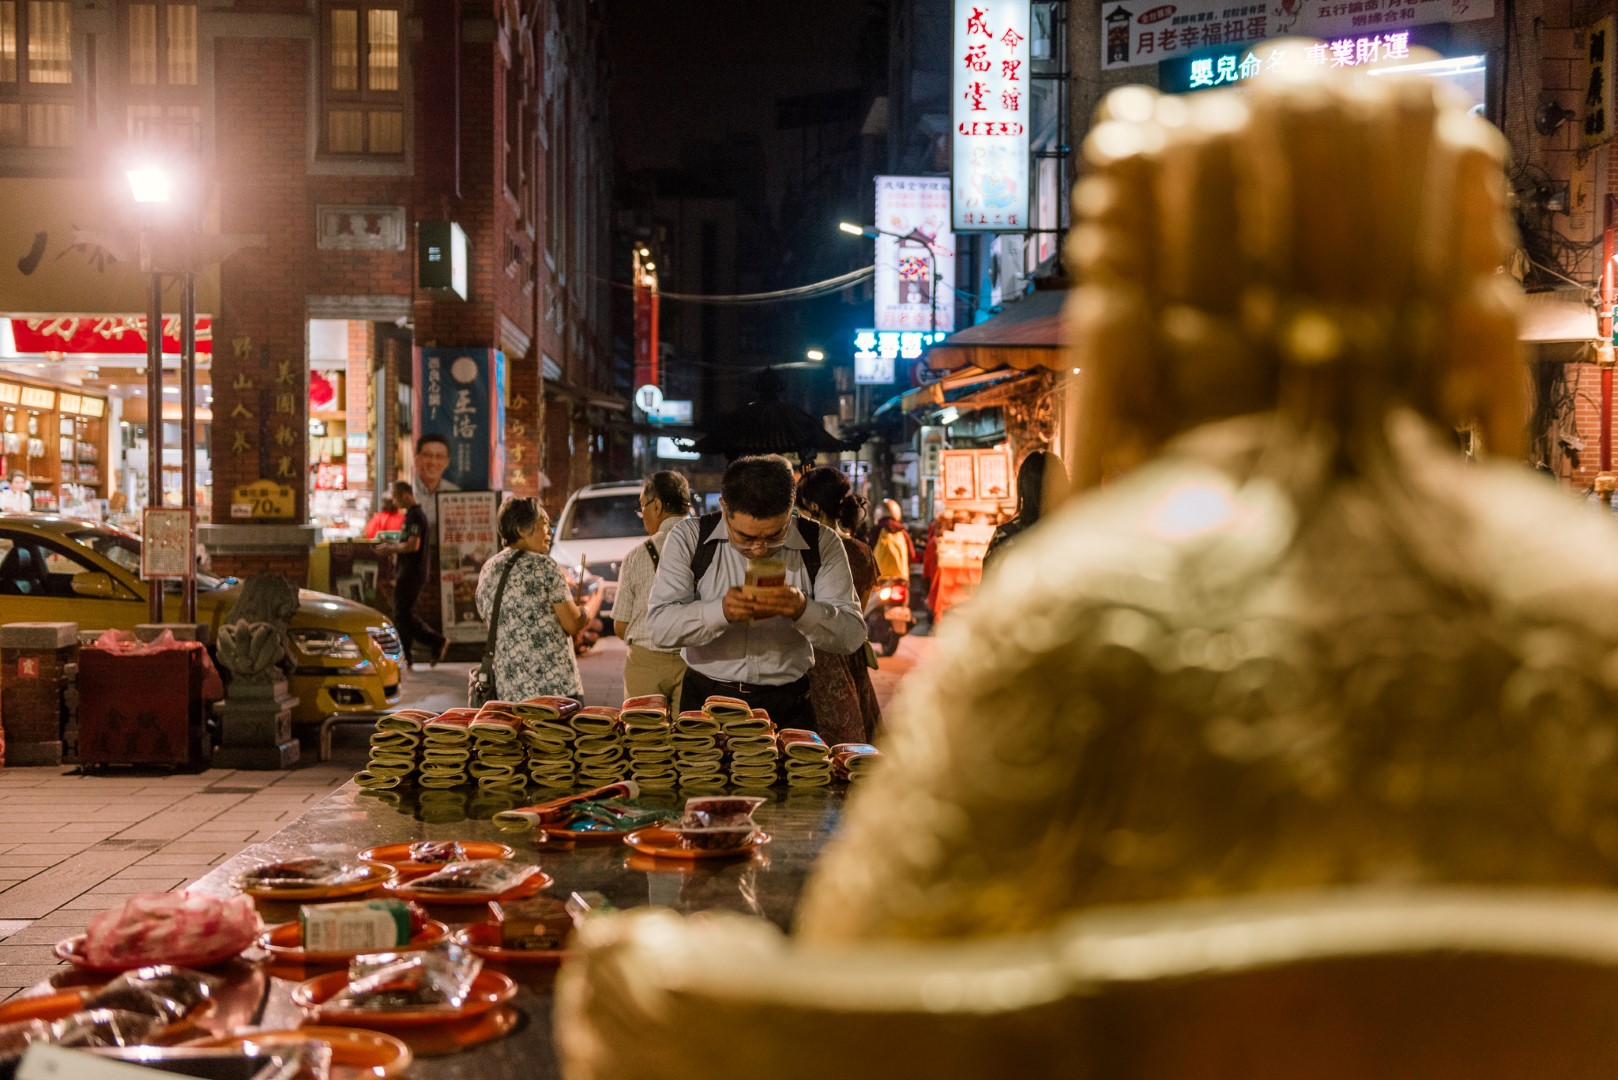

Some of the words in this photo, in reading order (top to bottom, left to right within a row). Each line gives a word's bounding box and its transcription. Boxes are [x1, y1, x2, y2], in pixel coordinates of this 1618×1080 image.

[964, 7, 993, 111] 成福堂
[1000, 28, 1024, 111] 命理館
[1136, 15, 1267, 55] 月老幸福扭蛋
